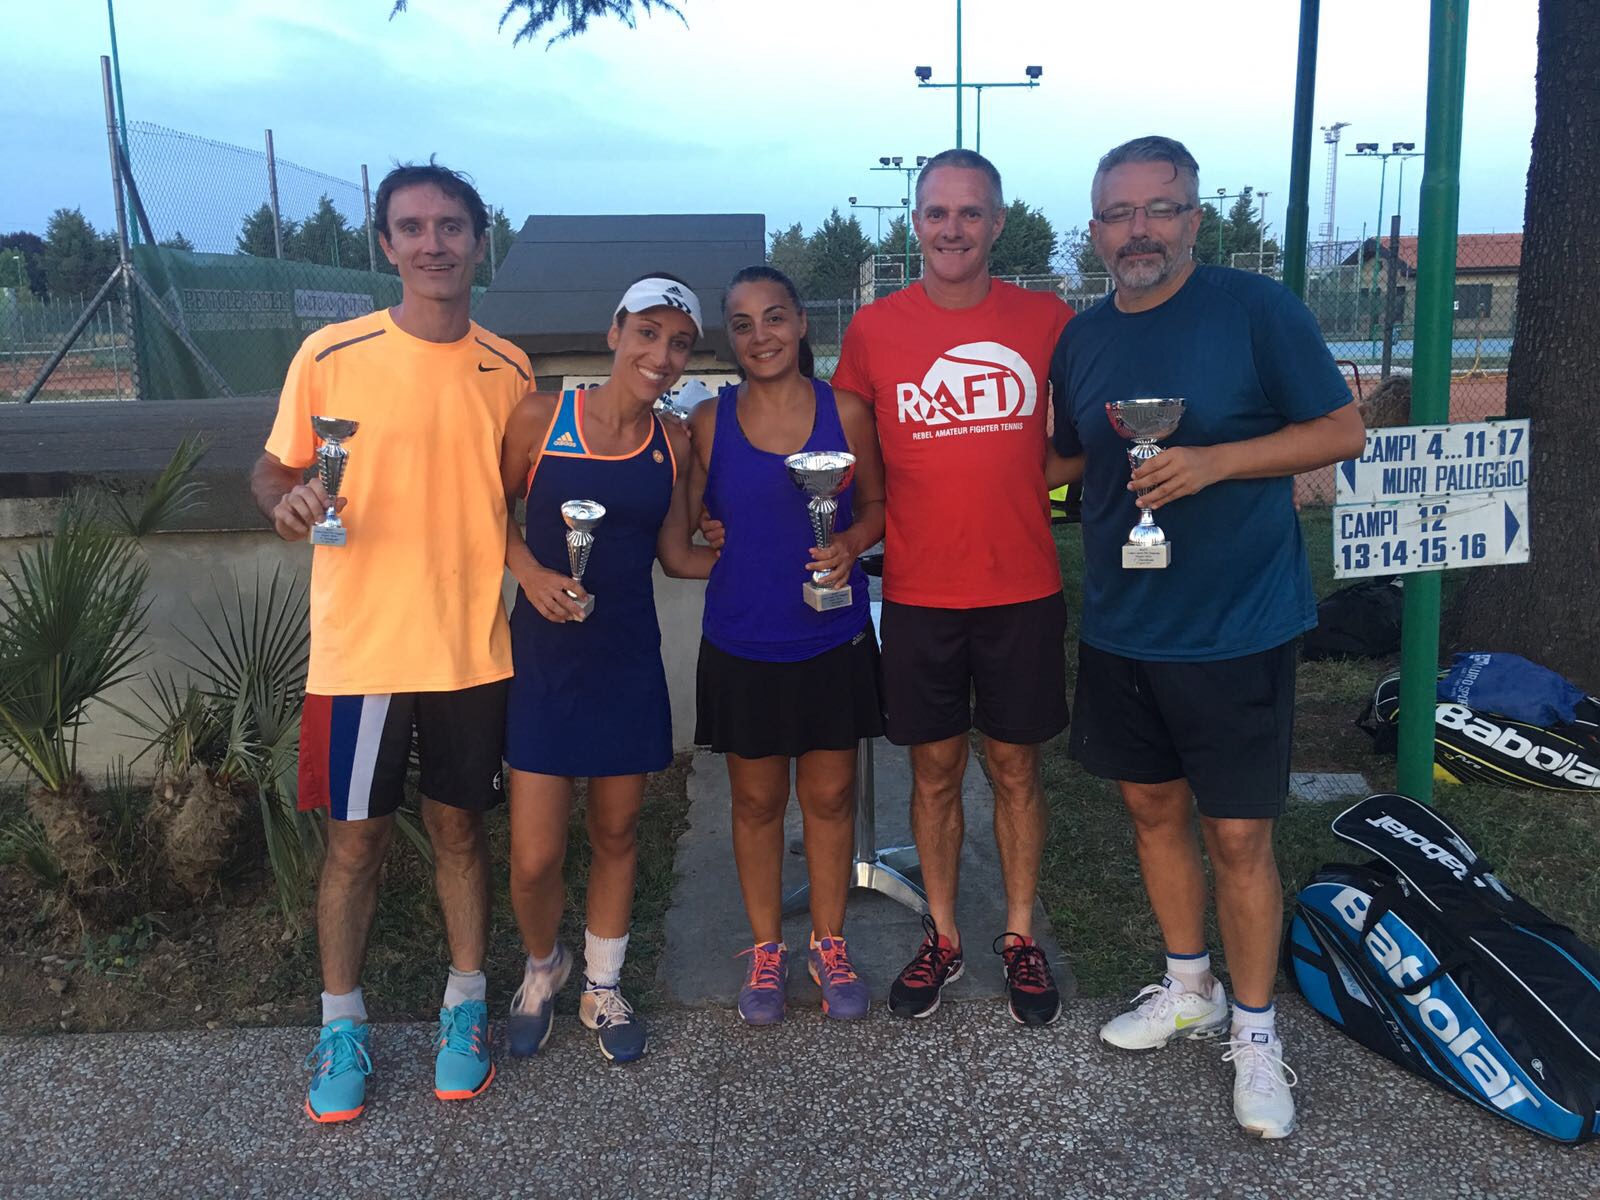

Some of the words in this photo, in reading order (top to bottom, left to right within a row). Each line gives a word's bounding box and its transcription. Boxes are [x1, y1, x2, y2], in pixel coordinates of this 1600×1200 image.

[897, 371, 1012, 423] RAFT
[912, 431, 934, 440] REBEL
[935, 427, 968, 438] AMATEUR
[969, 424, 999, 434] FIGHTER
[1000, 422, 1024, 431] TENNIS
[1359, 434, 1417, 464] CAMPI
[1383, 466, 1427, 494] MURI
[1435, 460, 1525, 491] PALLEGGIO
[1341, 510, 1398, 540] CAMPI
[1418, 505, 1447, 532] 12
[1435, 703, 1600, 788] Babola
[1331, 886, 1541, 1110] Babolat
